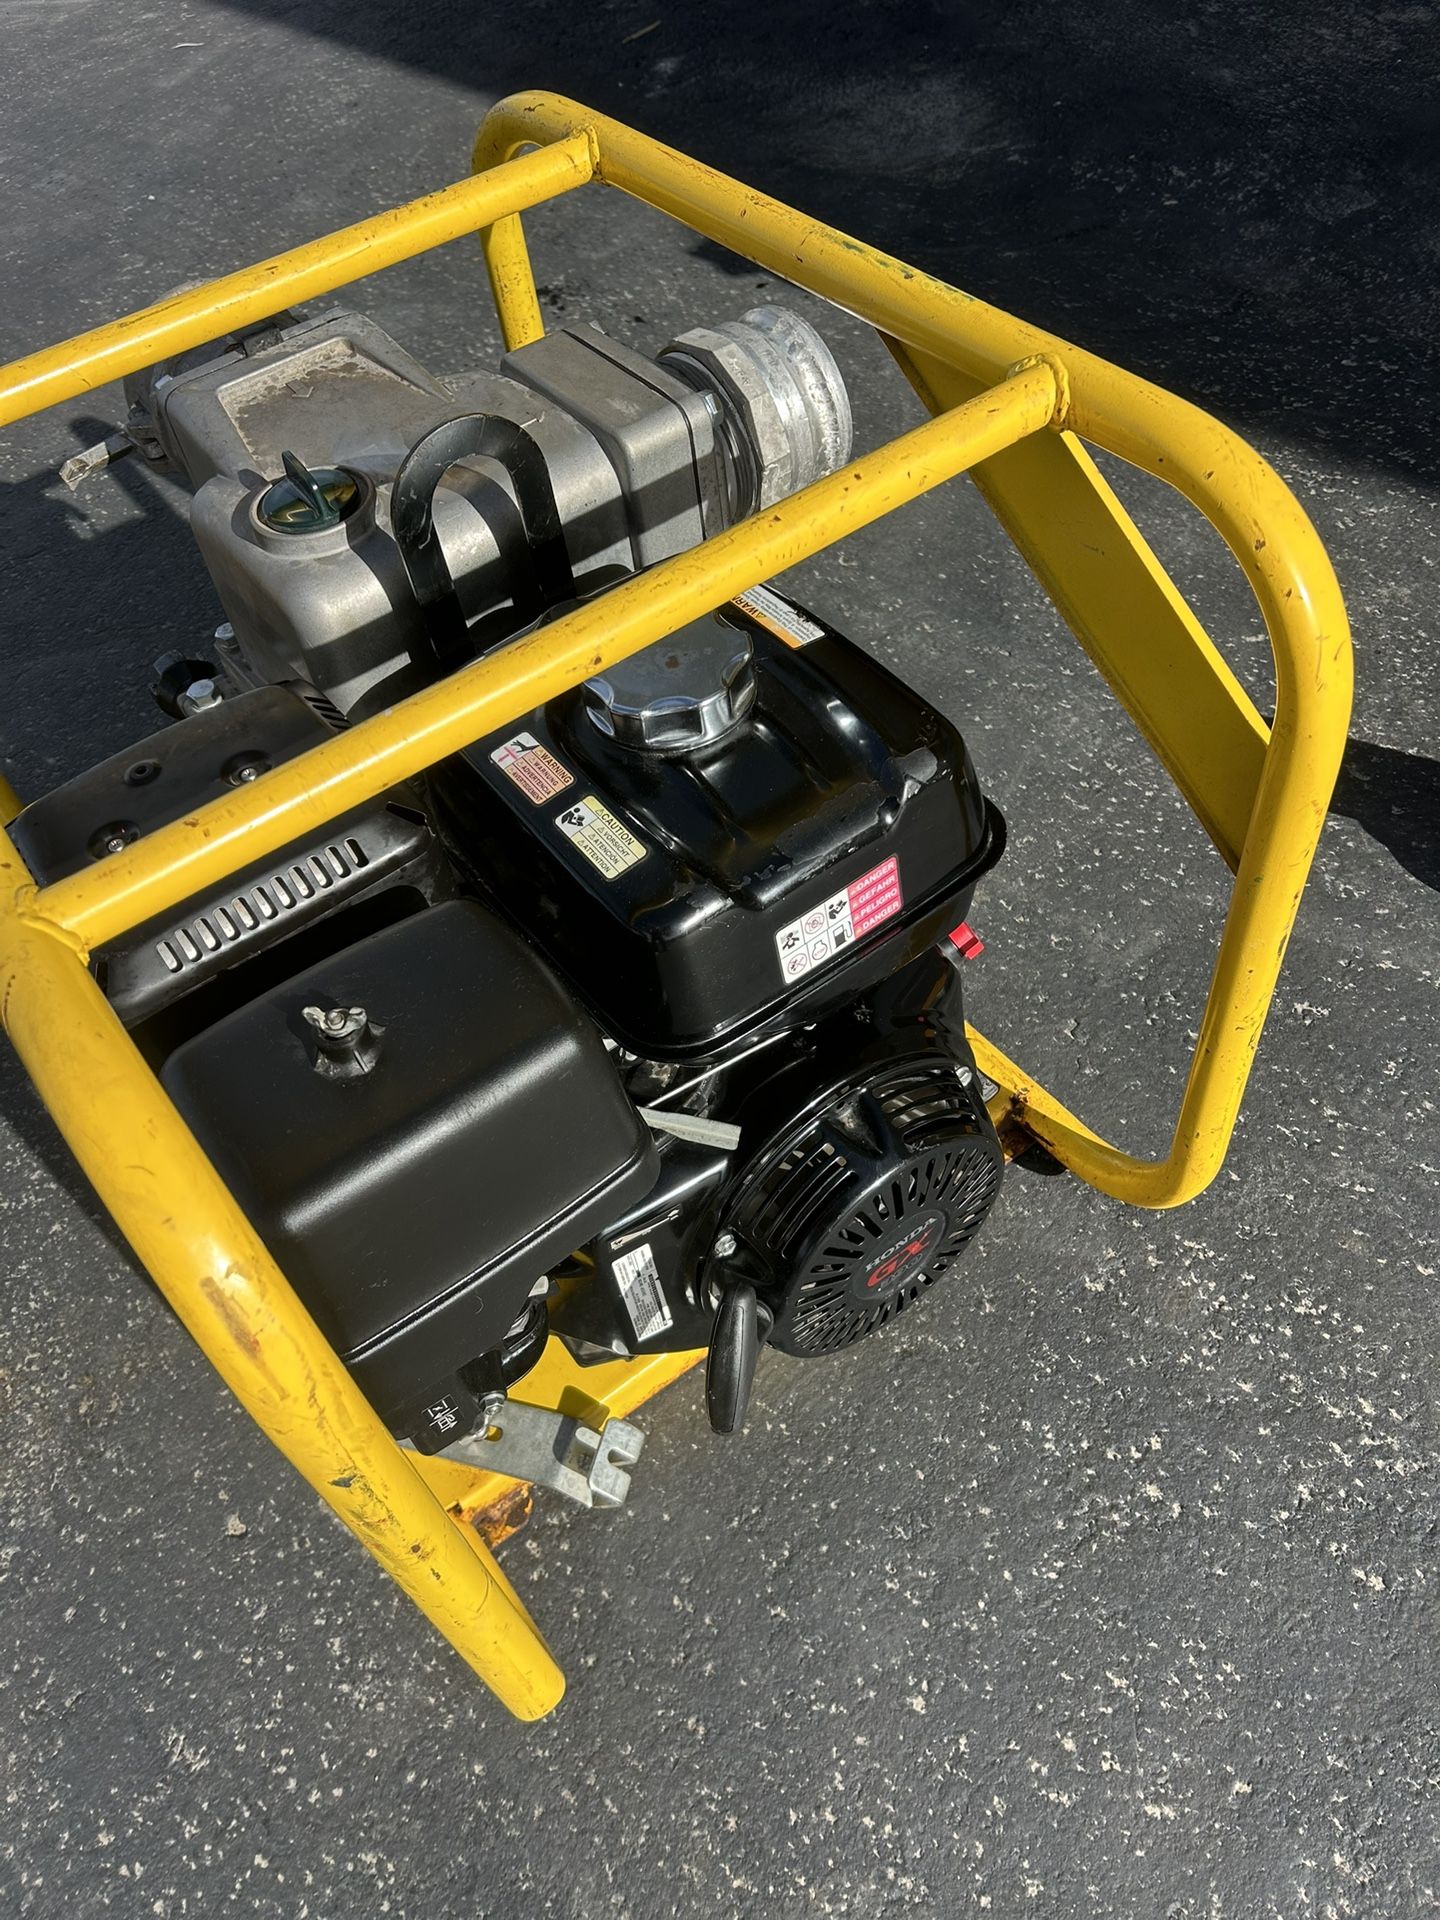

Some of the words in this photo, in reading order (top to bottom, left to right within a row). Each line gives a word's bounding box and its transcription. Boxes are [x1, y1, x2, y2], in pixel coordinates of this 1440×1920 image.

[522, 765, 552, 795] ADVERTENCIA
[534, 761, 559, 786] WARNUNG
[541, 752, 573, 784] WARNING
[601, 813, 635, 846] CAUTION
[603, 830, 630, 857] VORSICHT
[582, 844, 611, 873] ATTENTION
[856, 861, 895, 891] DANGER
[859, 874, 896, 904] GEFAHR
[860, 887, 898, 917] PELIGRO
[862, 901, 899, 930] DANGER
[865, 1217, 937, 1273] HONDA
[866, 1227, 934, 1288] GX
